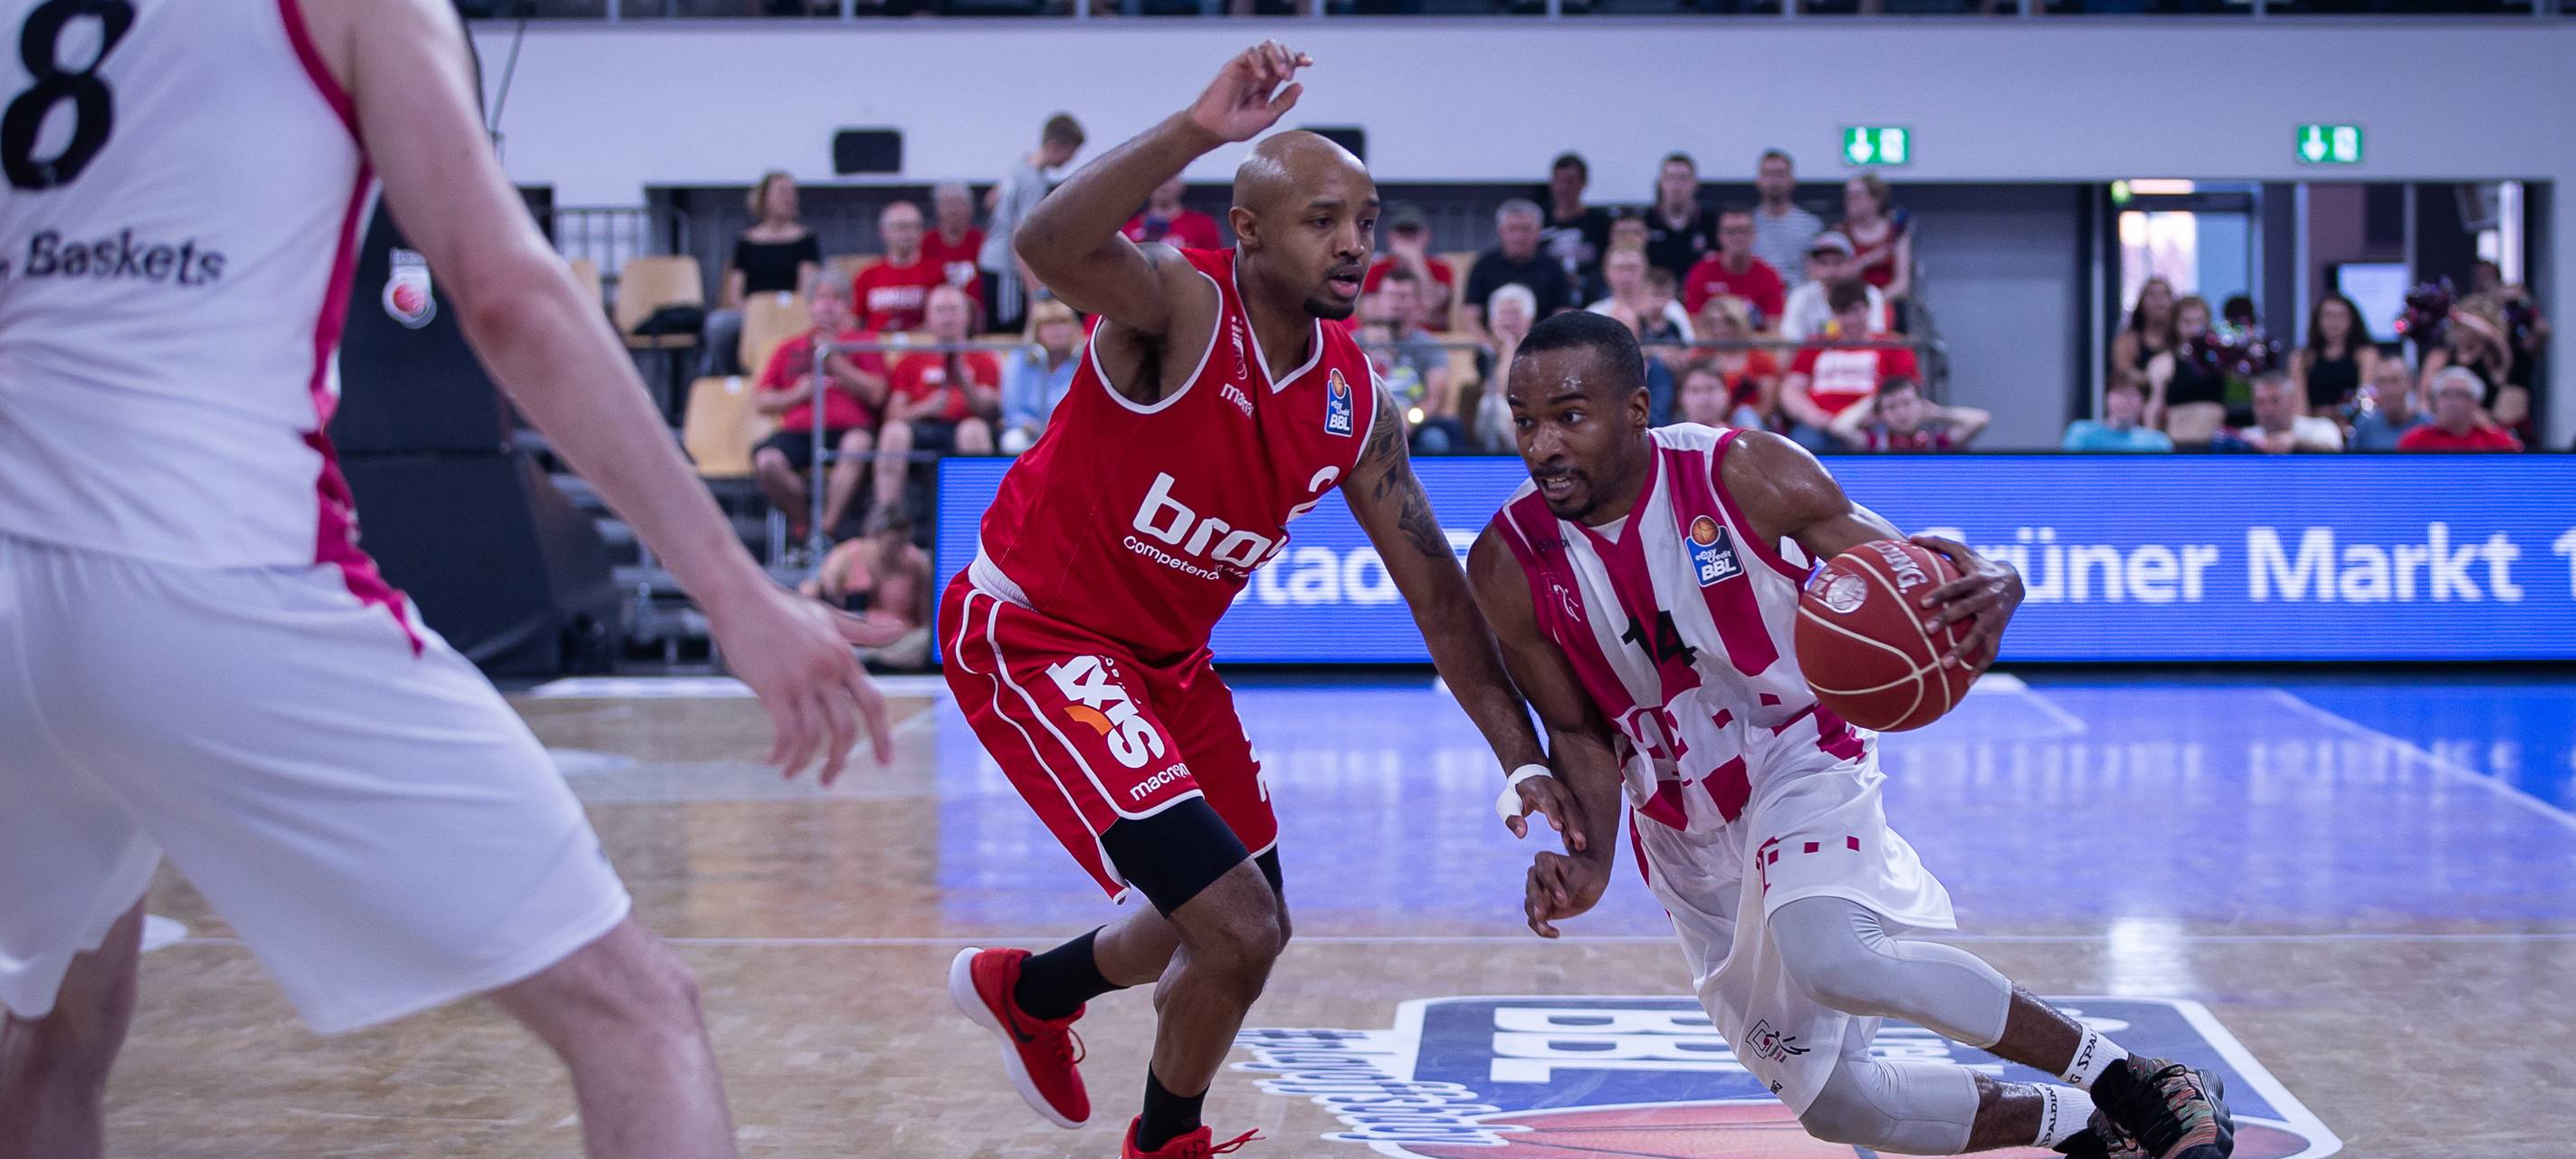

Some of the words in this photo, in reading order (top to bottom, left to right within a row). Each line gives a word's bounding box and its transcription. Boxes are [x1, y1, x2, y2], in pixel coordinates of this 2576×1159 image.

[1, 0, 137, 192] 8
[26, 226, 226, 285] Baskets
[1328, 414, 1350, 431] BBL
[1702, 558, 1736, 580] BBL
[2247, 522, 2524, 602] Markt
[1621, 610, 1698, 667] 14
